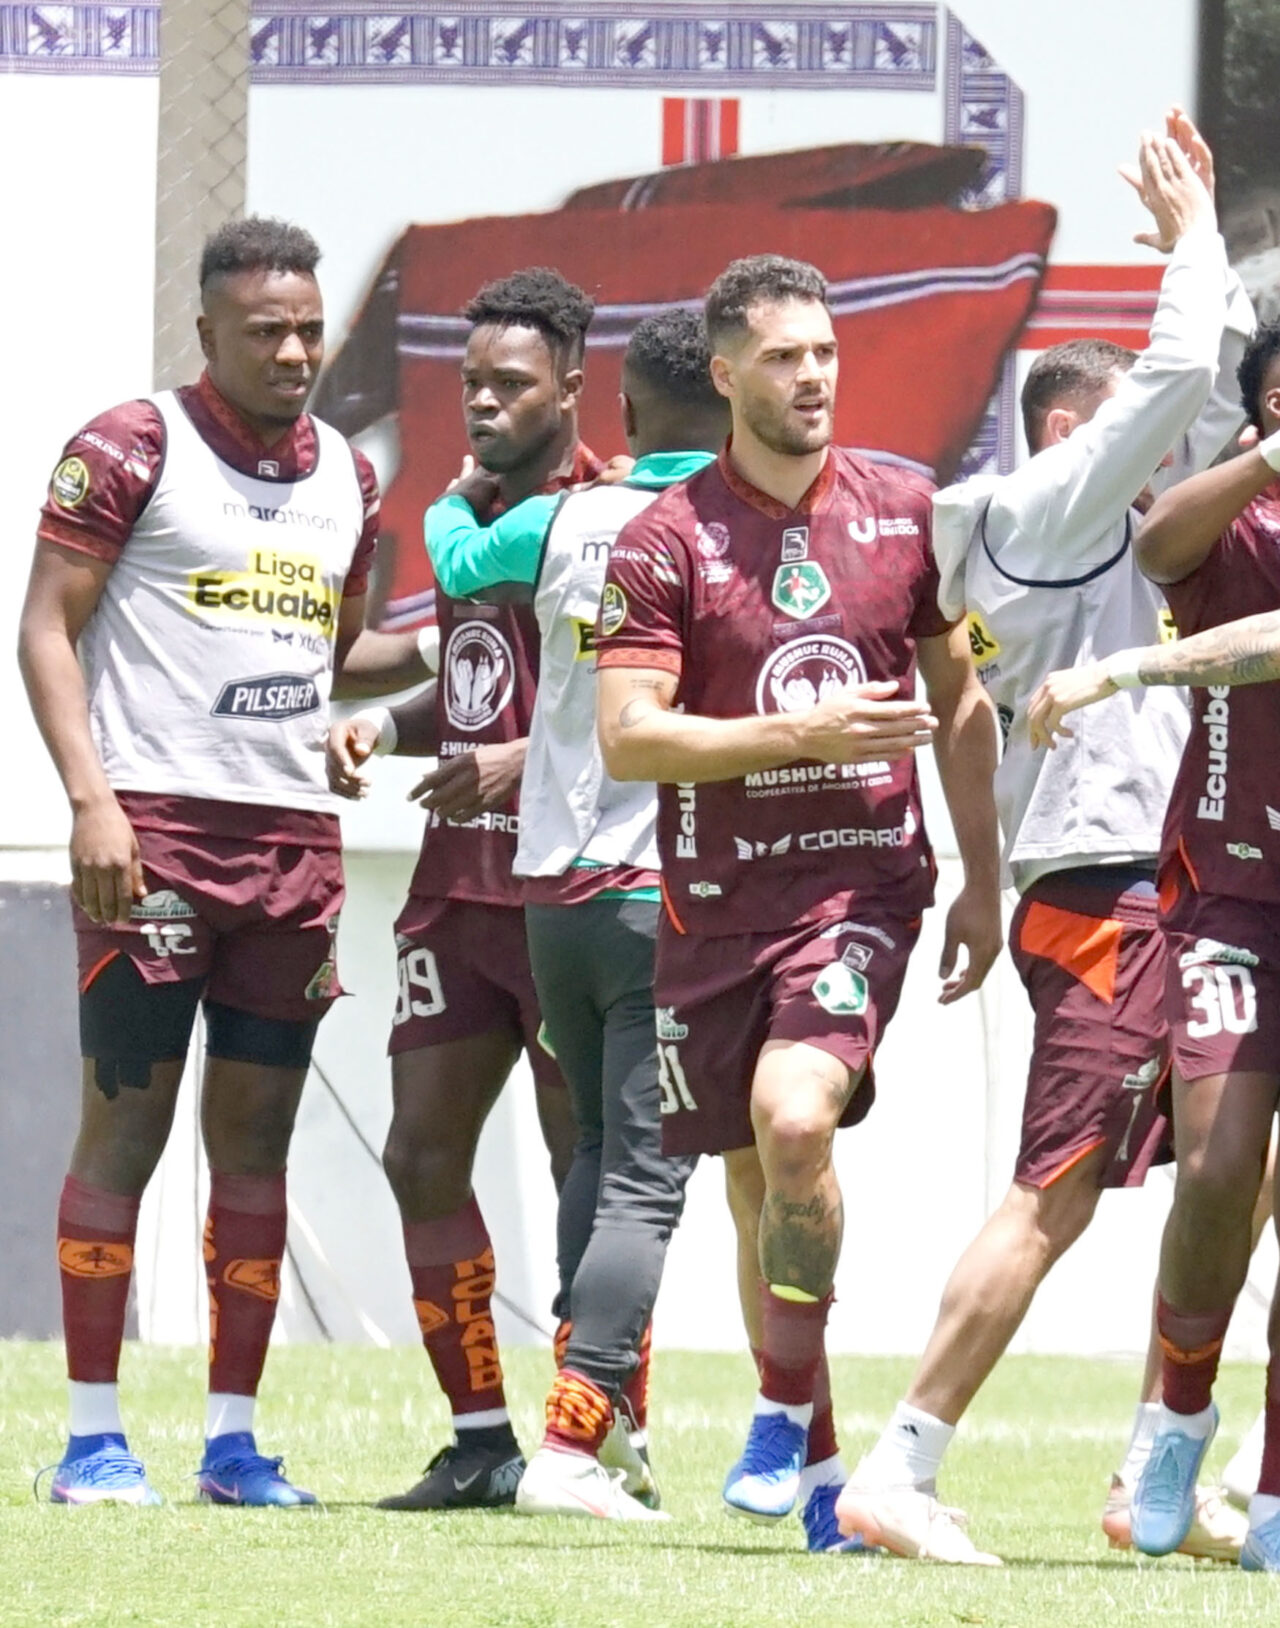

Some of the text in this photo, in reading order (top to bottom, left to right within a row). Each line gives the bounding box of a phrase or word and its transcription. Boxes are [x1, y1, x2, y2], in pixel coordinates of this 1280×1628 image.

[223, 501, 338, 533] marathon
[255, 552, 315, 586] Liga
[194, 577, 334, 627] Ecuabe
[231, 683, 314, 714] PILSENER
[1197, 685, 1231, 821] Ecuabe
[745, 764, 836, 787] MUSHUC
[1182, 966, 1258, 1037] 30
